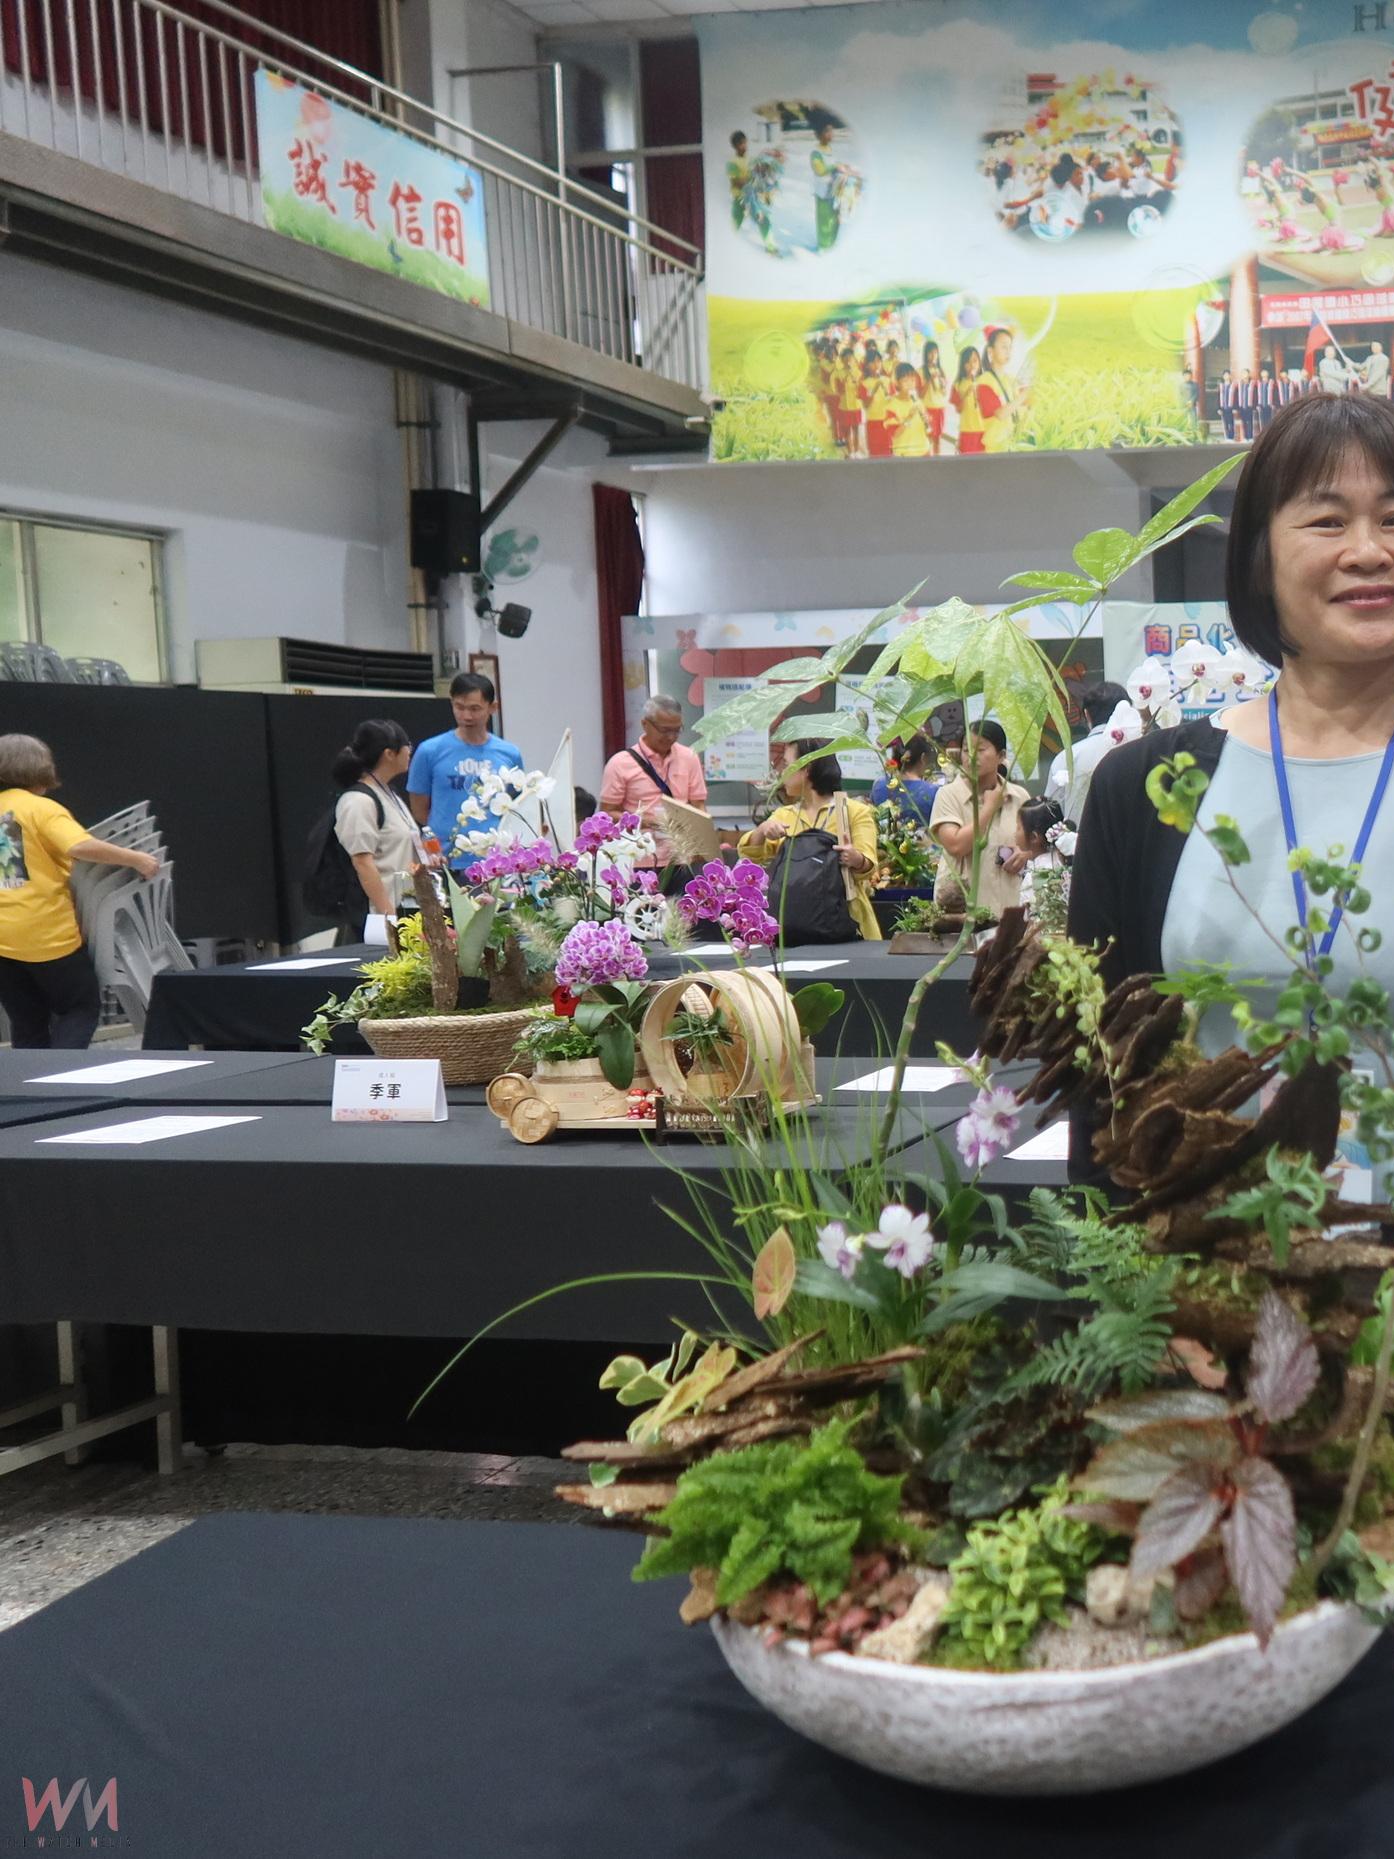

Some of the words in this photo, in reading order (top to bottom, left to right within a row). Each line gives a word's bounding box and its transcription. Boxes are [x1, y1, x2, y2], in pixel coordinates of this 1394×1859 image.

[288, 138, 464, 265] 誠實信用
[369, 1083, 402, 1099] 季軍
